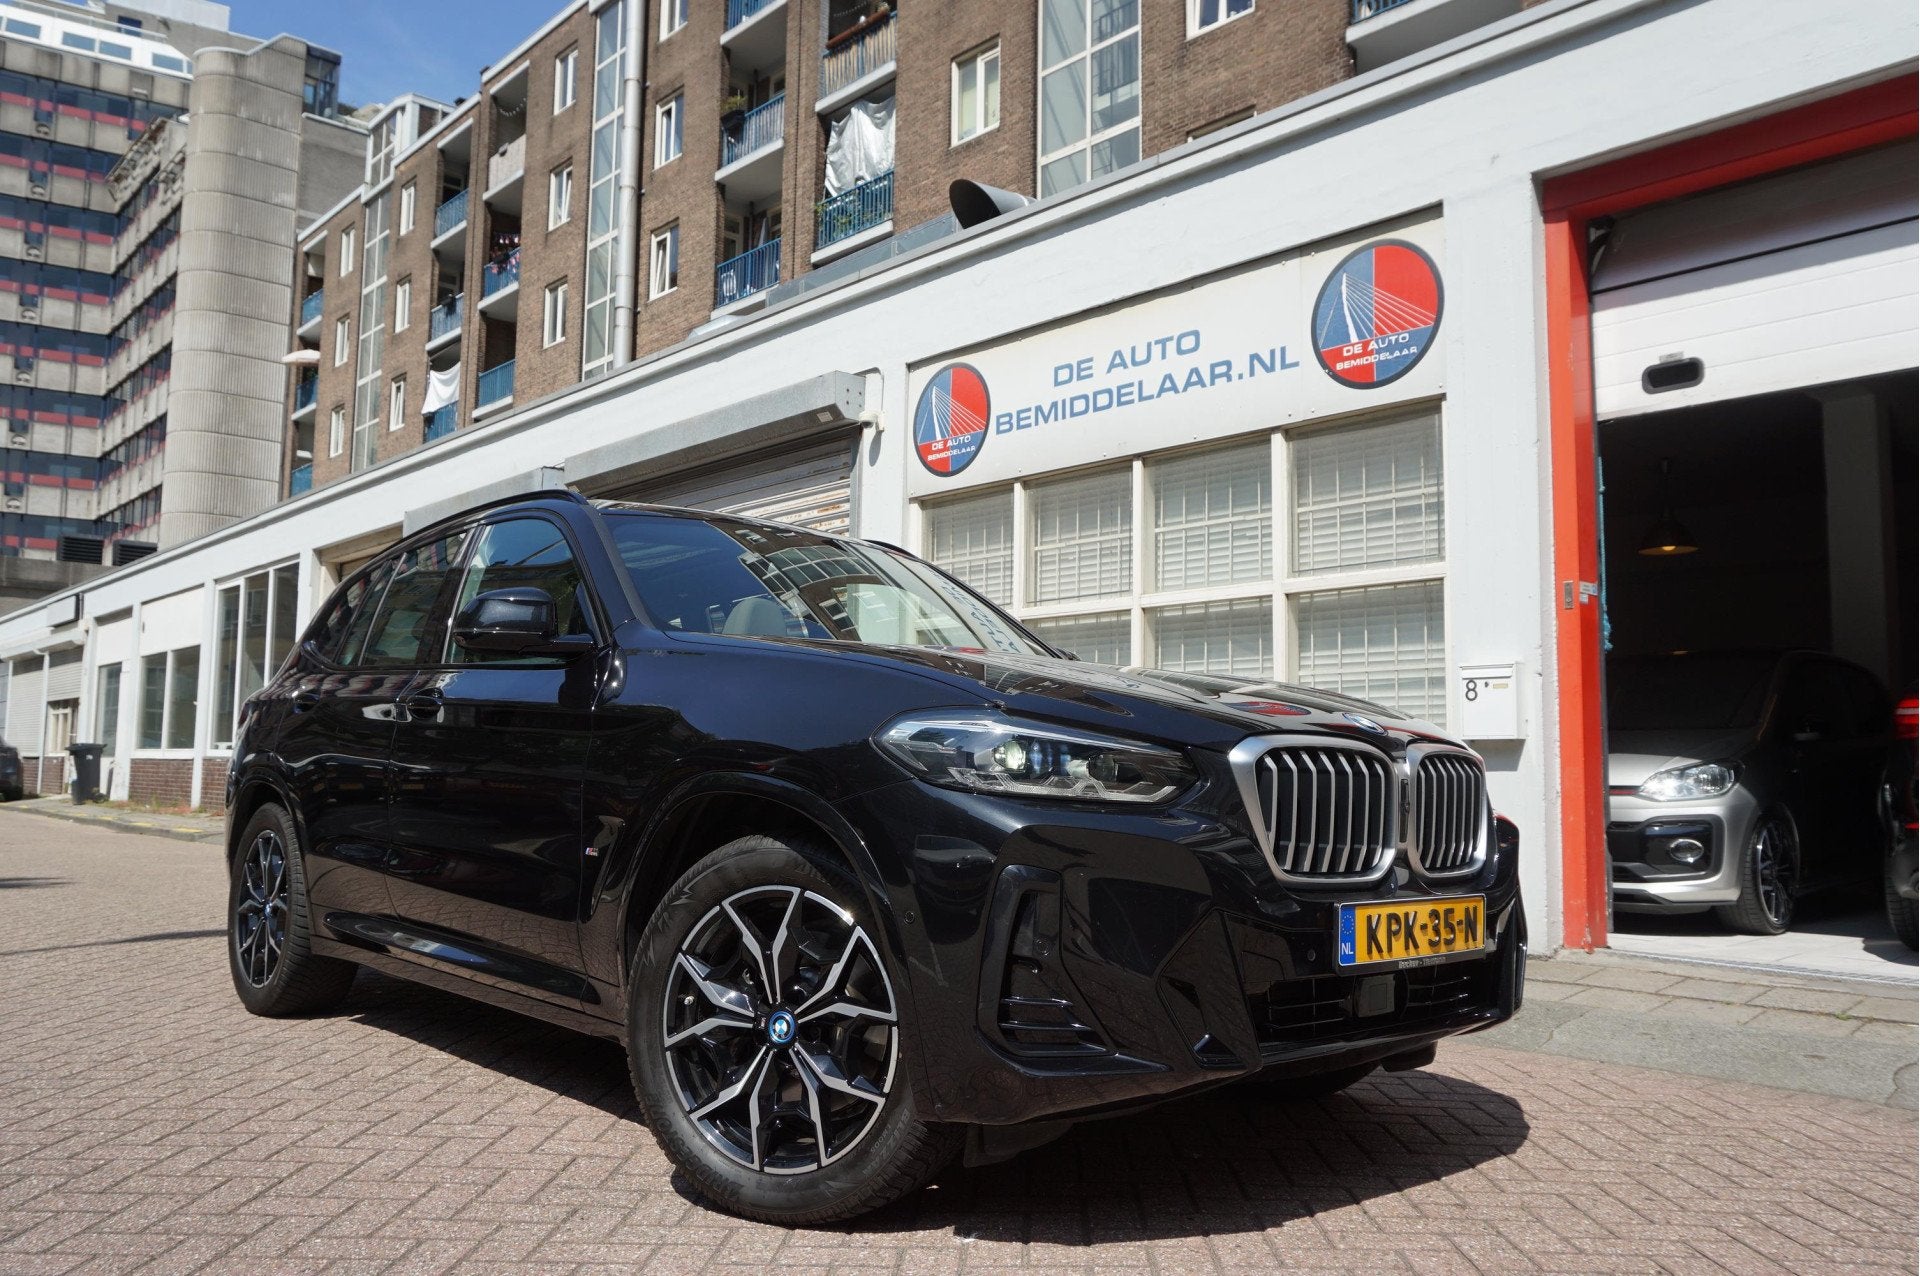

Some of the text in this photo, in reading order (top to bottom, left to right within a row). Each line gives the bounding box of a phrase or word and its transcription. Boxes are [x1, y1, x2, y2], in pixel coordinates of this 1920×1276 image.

[1343, 333, 1410, 357] DE AUTO
[1053, 329, 1201, 388] DE AUTO
[1336, 346, 1418, 371] BEMIDDELAAR
[995, 345, 1301, 436] BEMIDDELAAR.NL
[931, 435, 971, 451] DE AUTO
[1465, 679, 1478, 702] 8
[1366, 905, 1478, 955] KPK-35-N
[1341, 942, 1354, 955] NL
